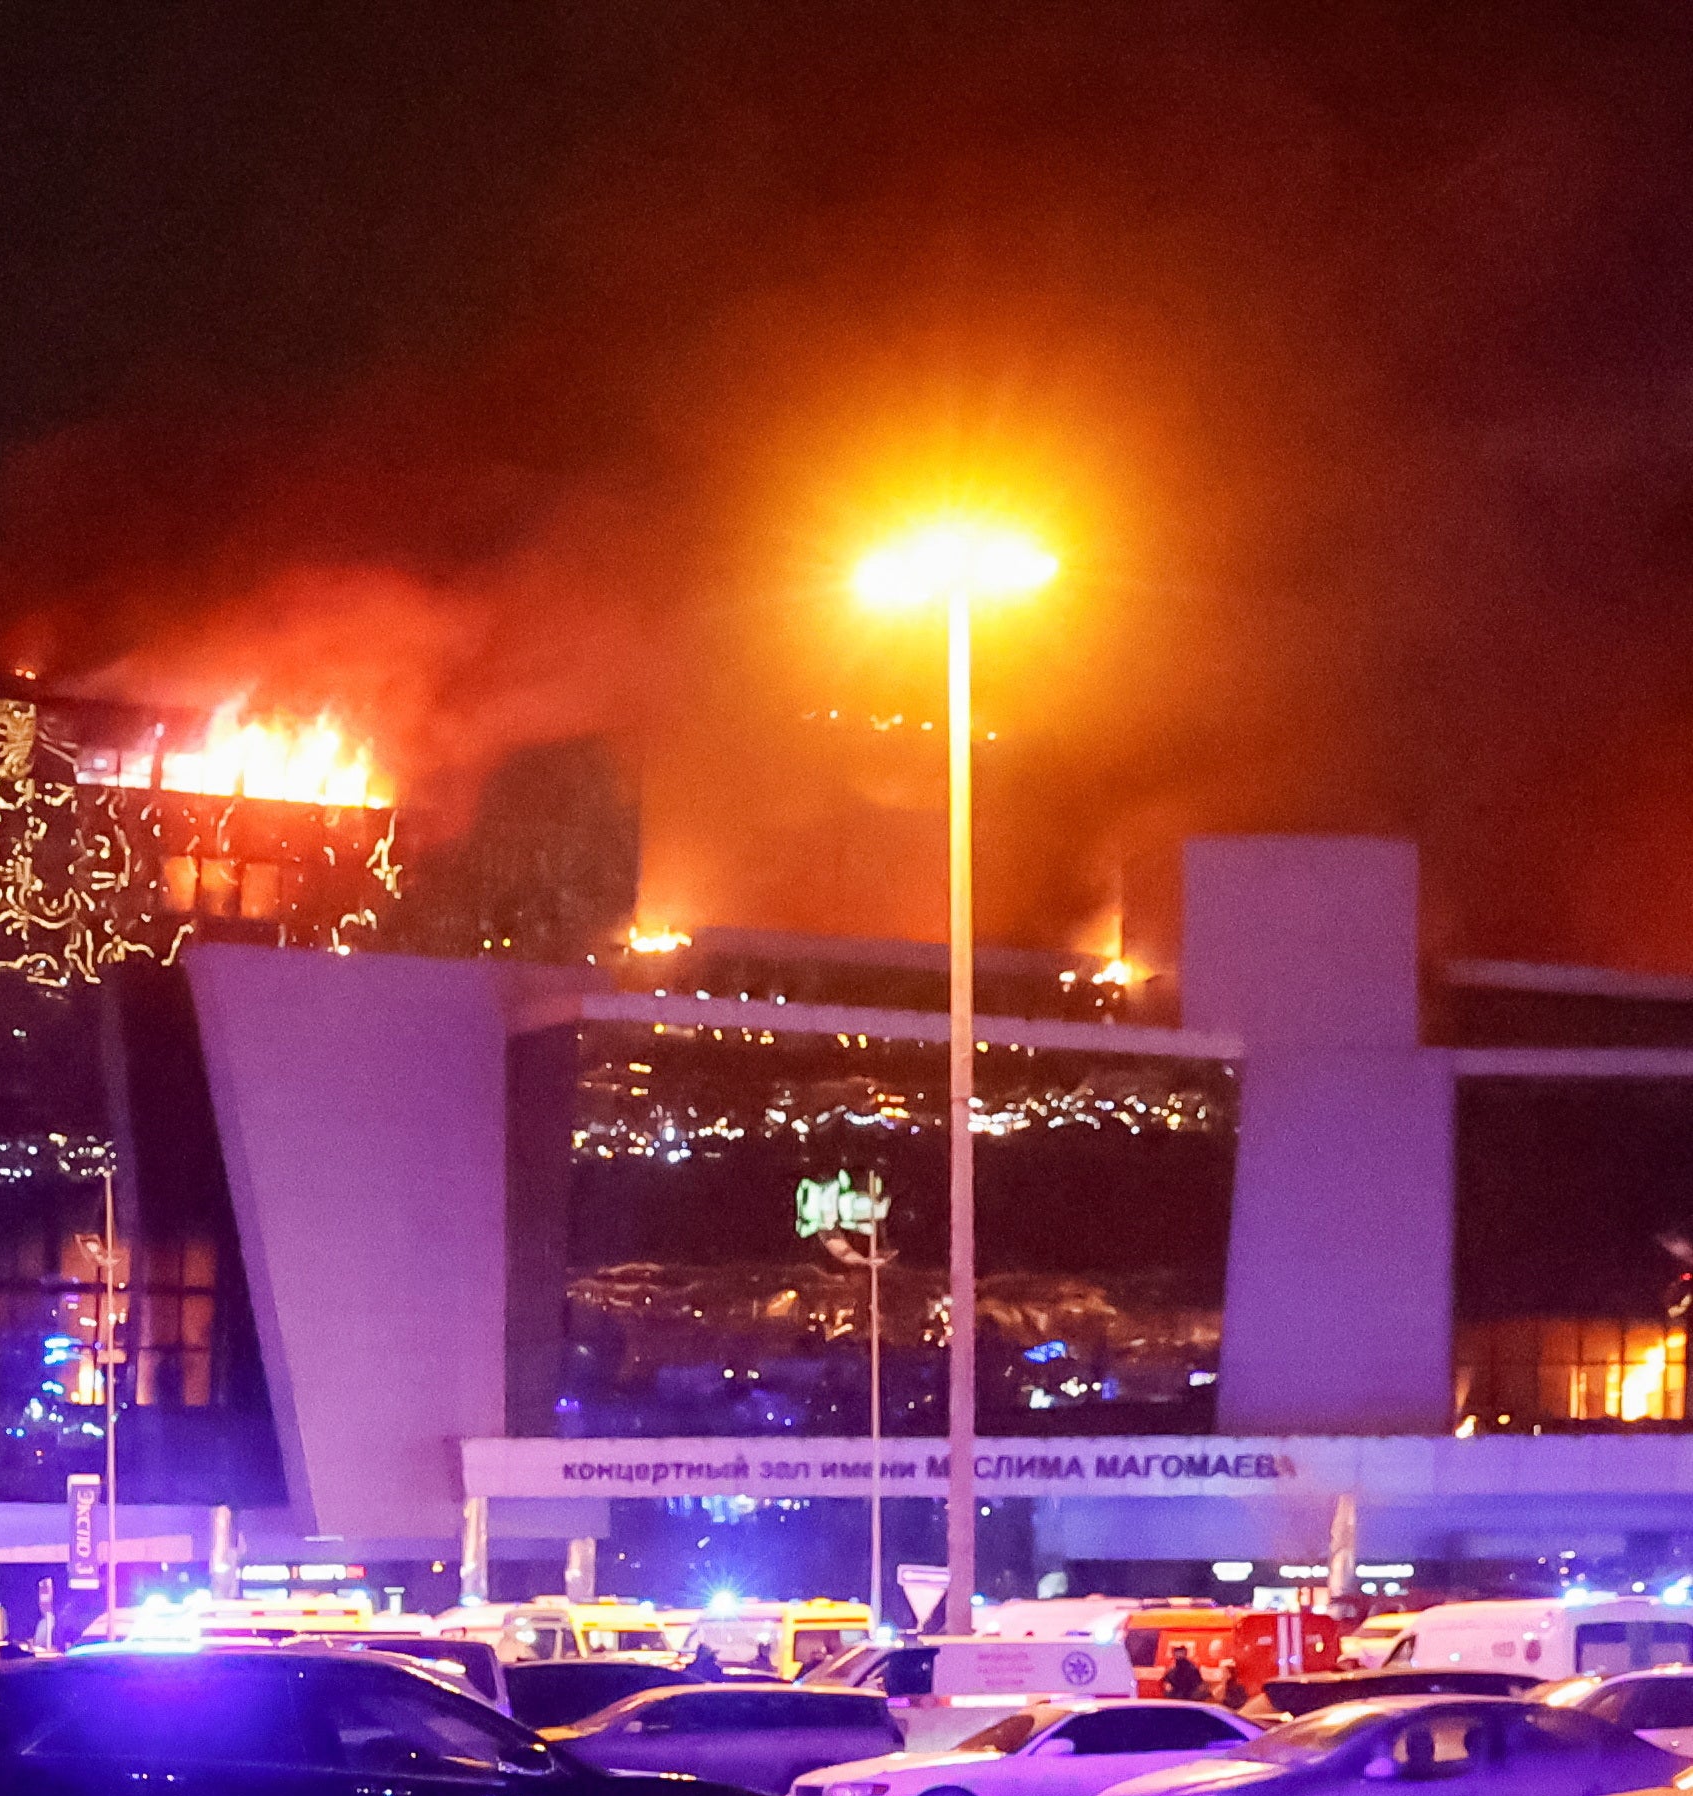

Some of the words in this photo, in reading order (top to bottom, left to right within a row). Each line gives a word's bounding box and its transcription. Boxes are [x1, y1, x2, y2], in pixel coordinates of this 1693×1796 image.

[562, 1452, 750, 1485] концертный
[759, 1460, 810, 1480] зал
[926, 1454, 1085, 1480] МСЛИМА
